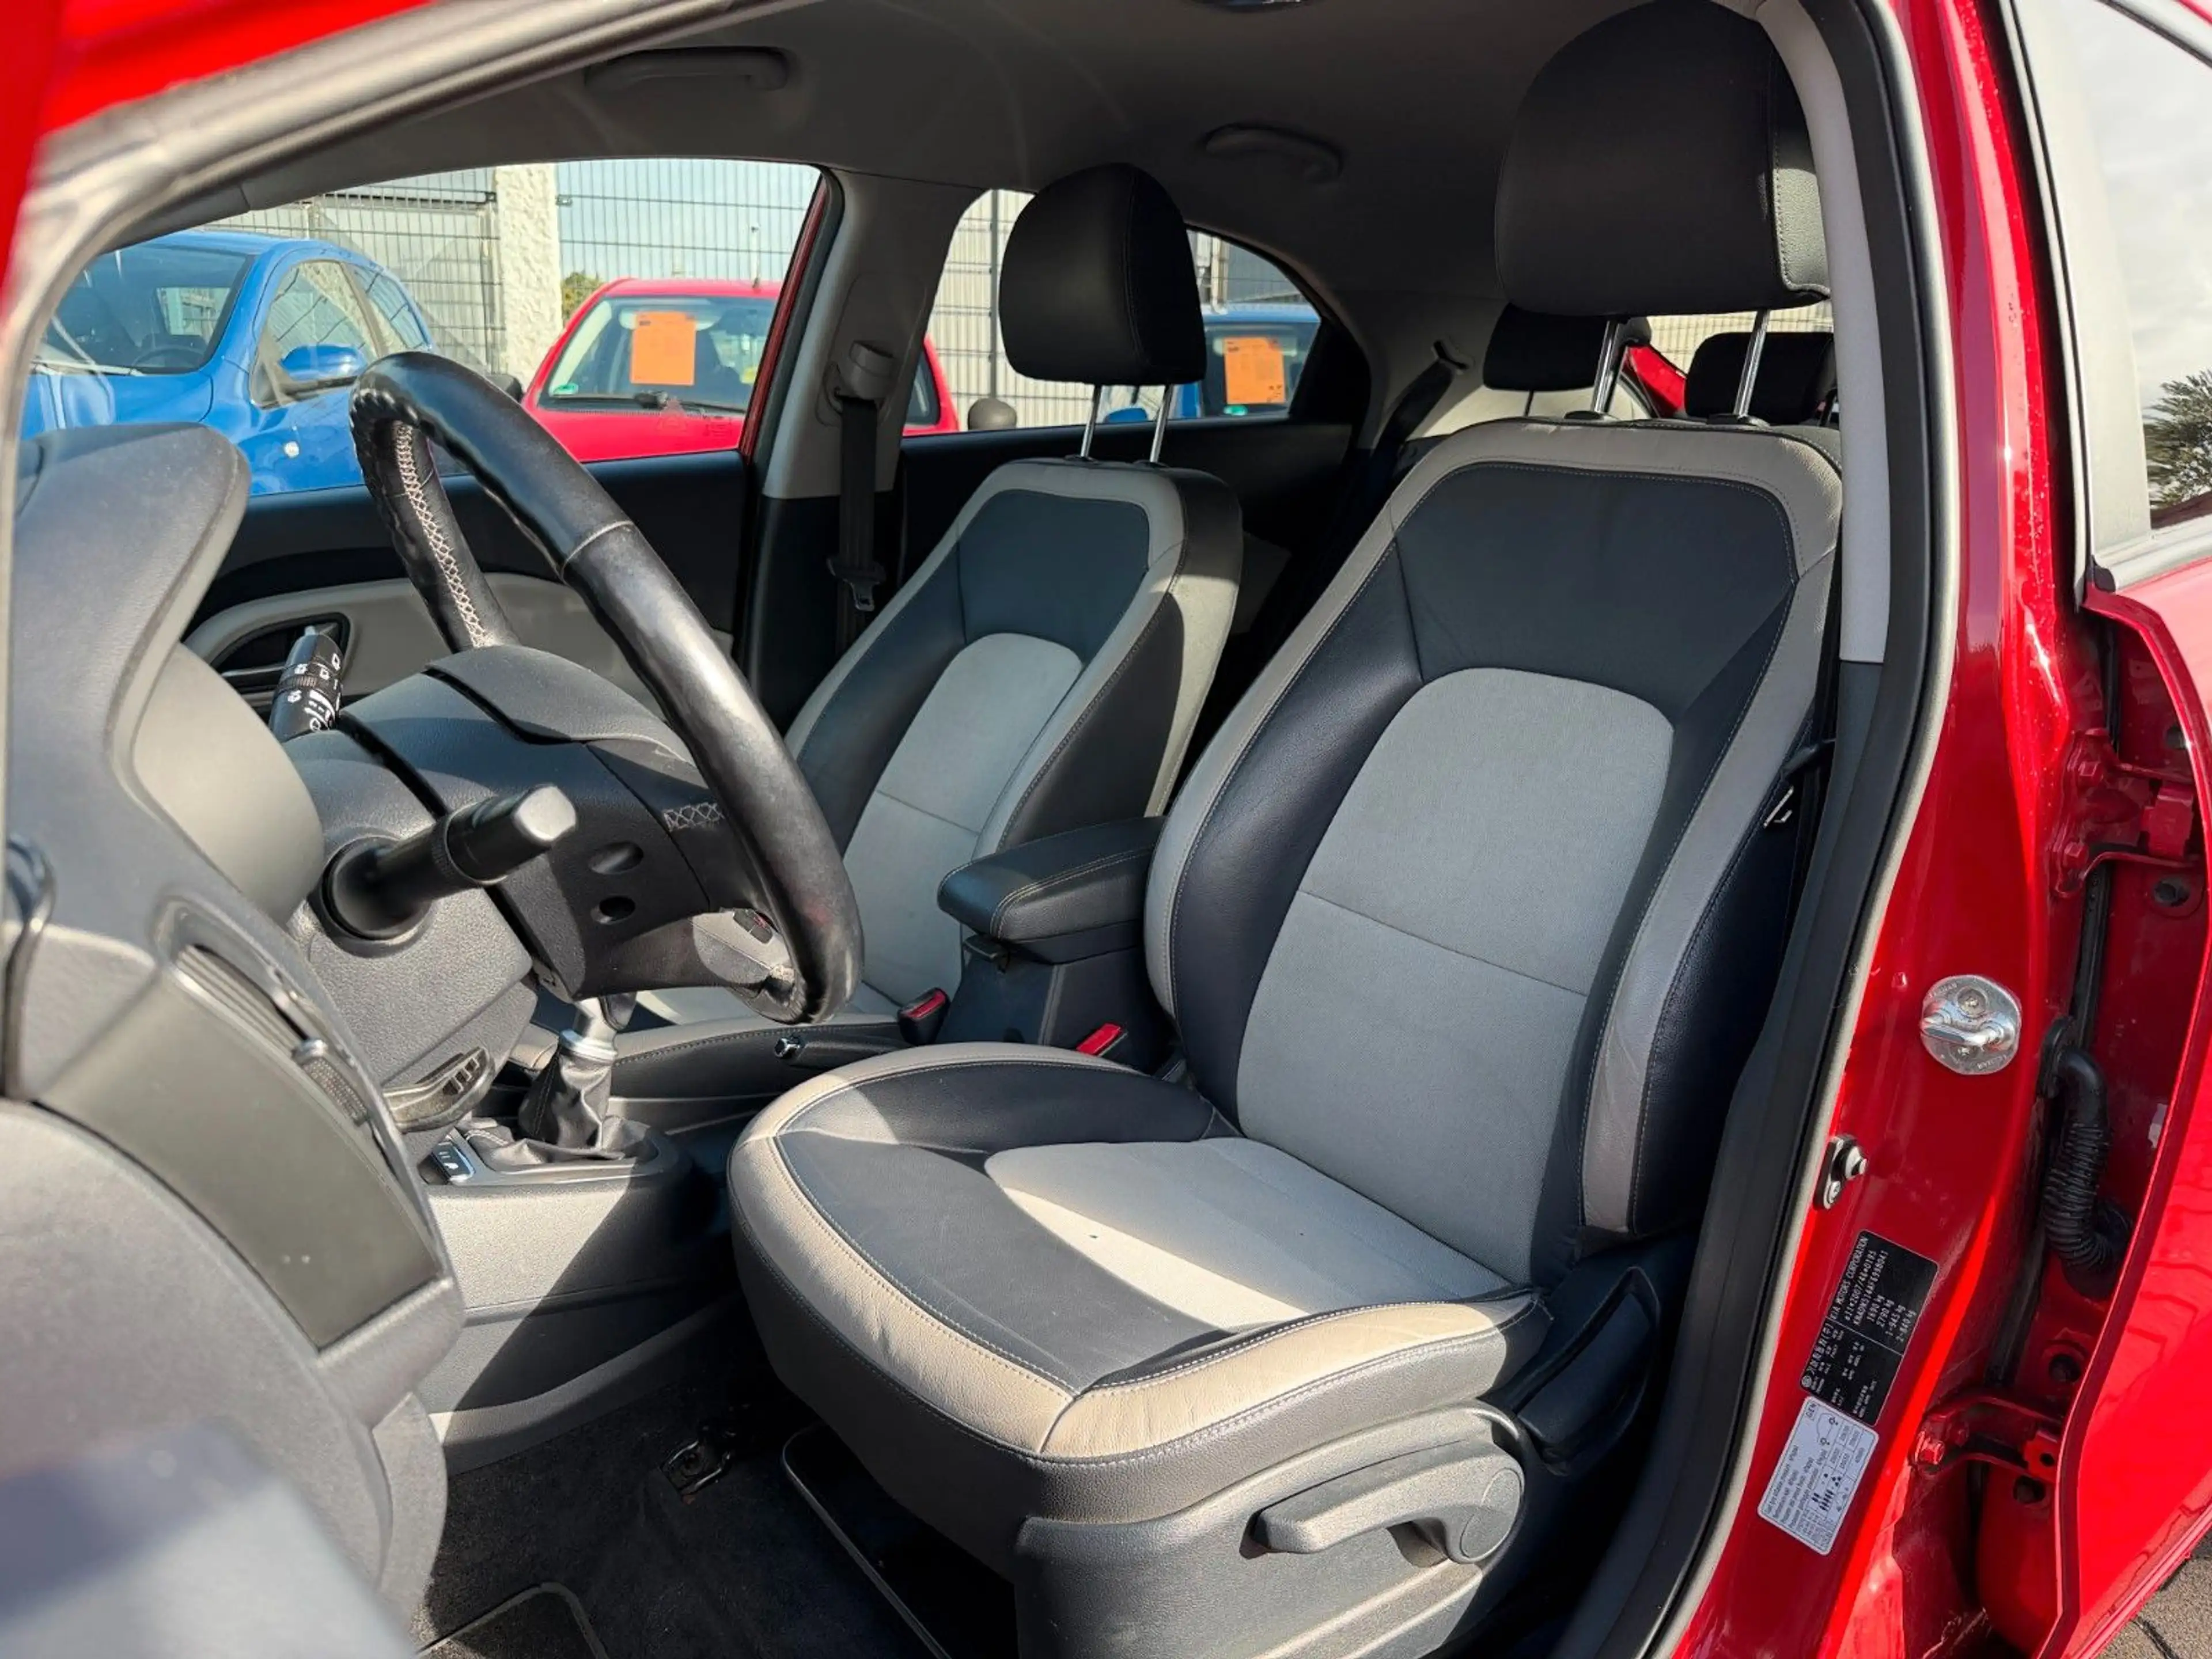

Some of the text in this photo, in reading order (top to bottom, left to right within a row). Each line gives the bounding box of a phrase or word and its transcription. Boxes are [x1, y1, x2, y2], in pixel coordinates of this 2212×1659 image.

[1828, 1305, 1840, 1320] KIA
[1834, 1278, 1850, 1305] MOTORS
[1844, 1236, 1868, 1279] CORPORATION
[1873, 1294, 1885, 1302] kg
[1883, 1298, 1895, 1307] kg
[1895, 1304, 1906, 1313] kg
[1904, 1309, 1916, 1317] kg
